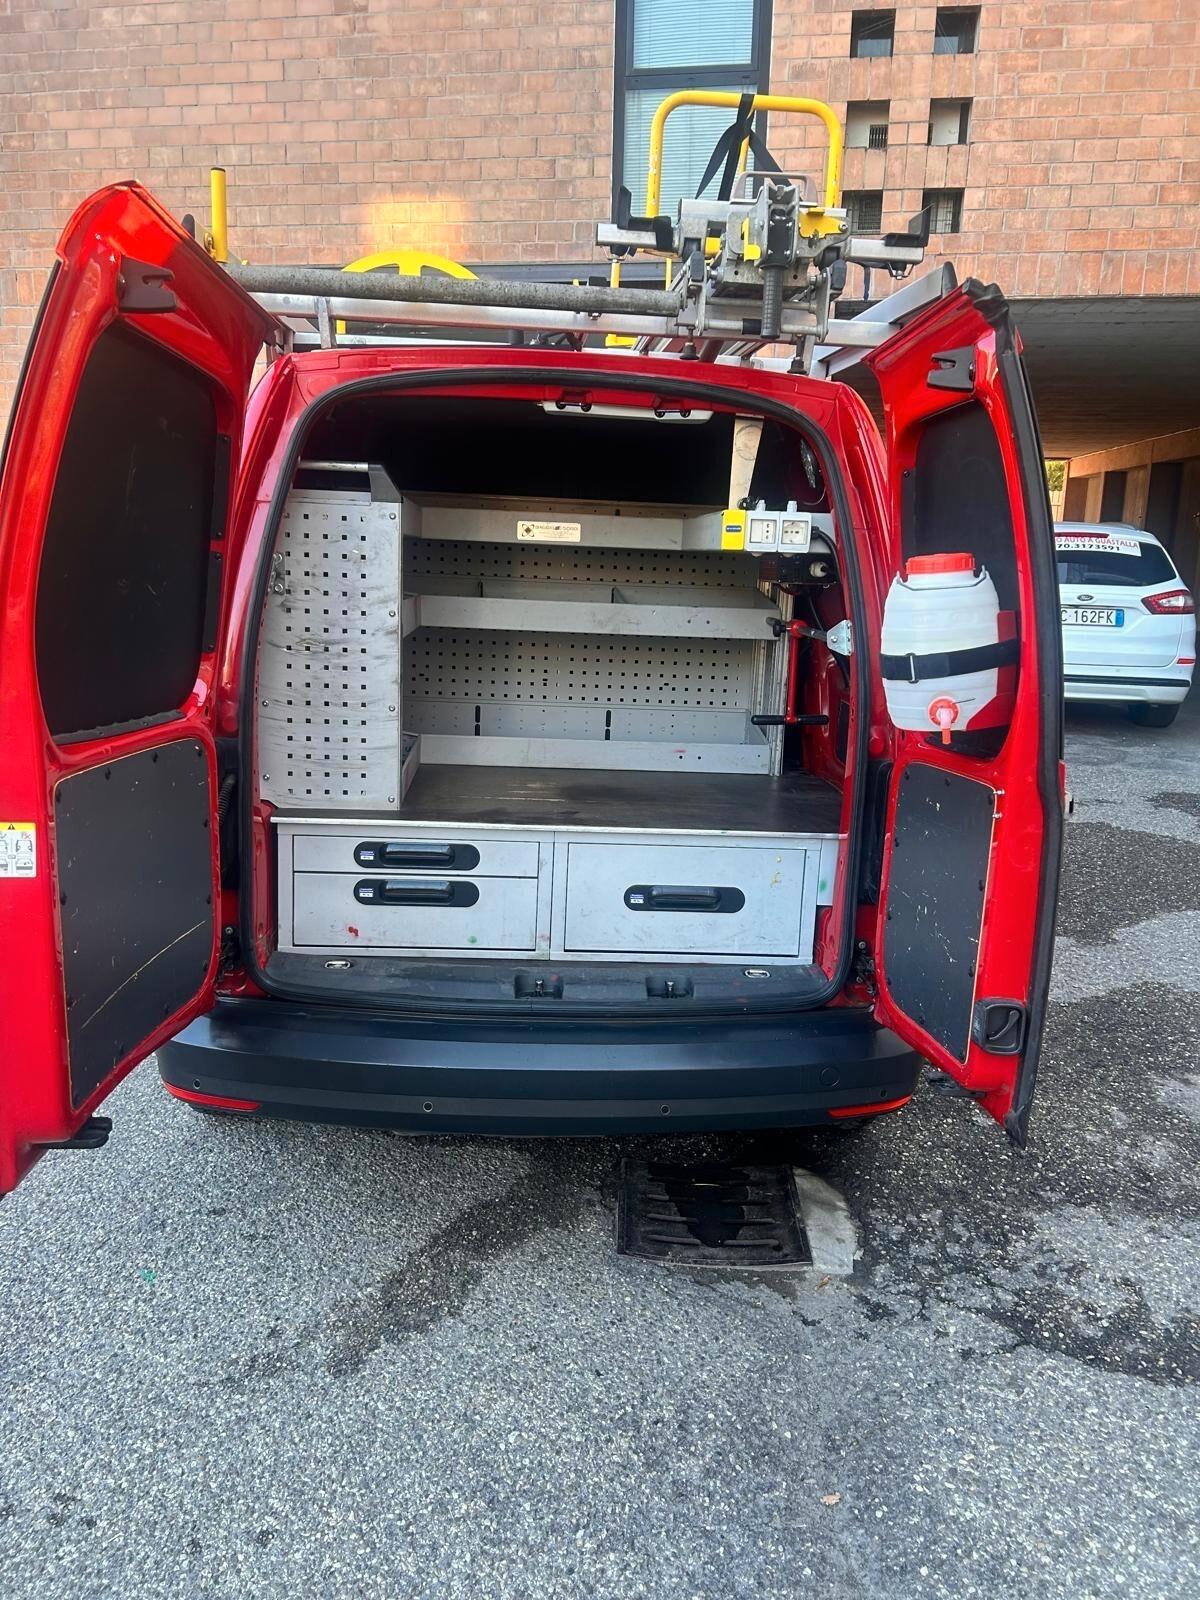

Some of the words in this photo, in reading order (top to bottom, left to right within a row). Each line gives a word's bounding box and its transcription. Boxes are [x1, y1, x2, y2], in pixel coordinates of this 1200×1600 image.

[1057, 543, 1120, 551] 70.3173591
[1095, 537, 1138, 548] GUASTALLA
[1074, 610, 1114, 624] 162FK
